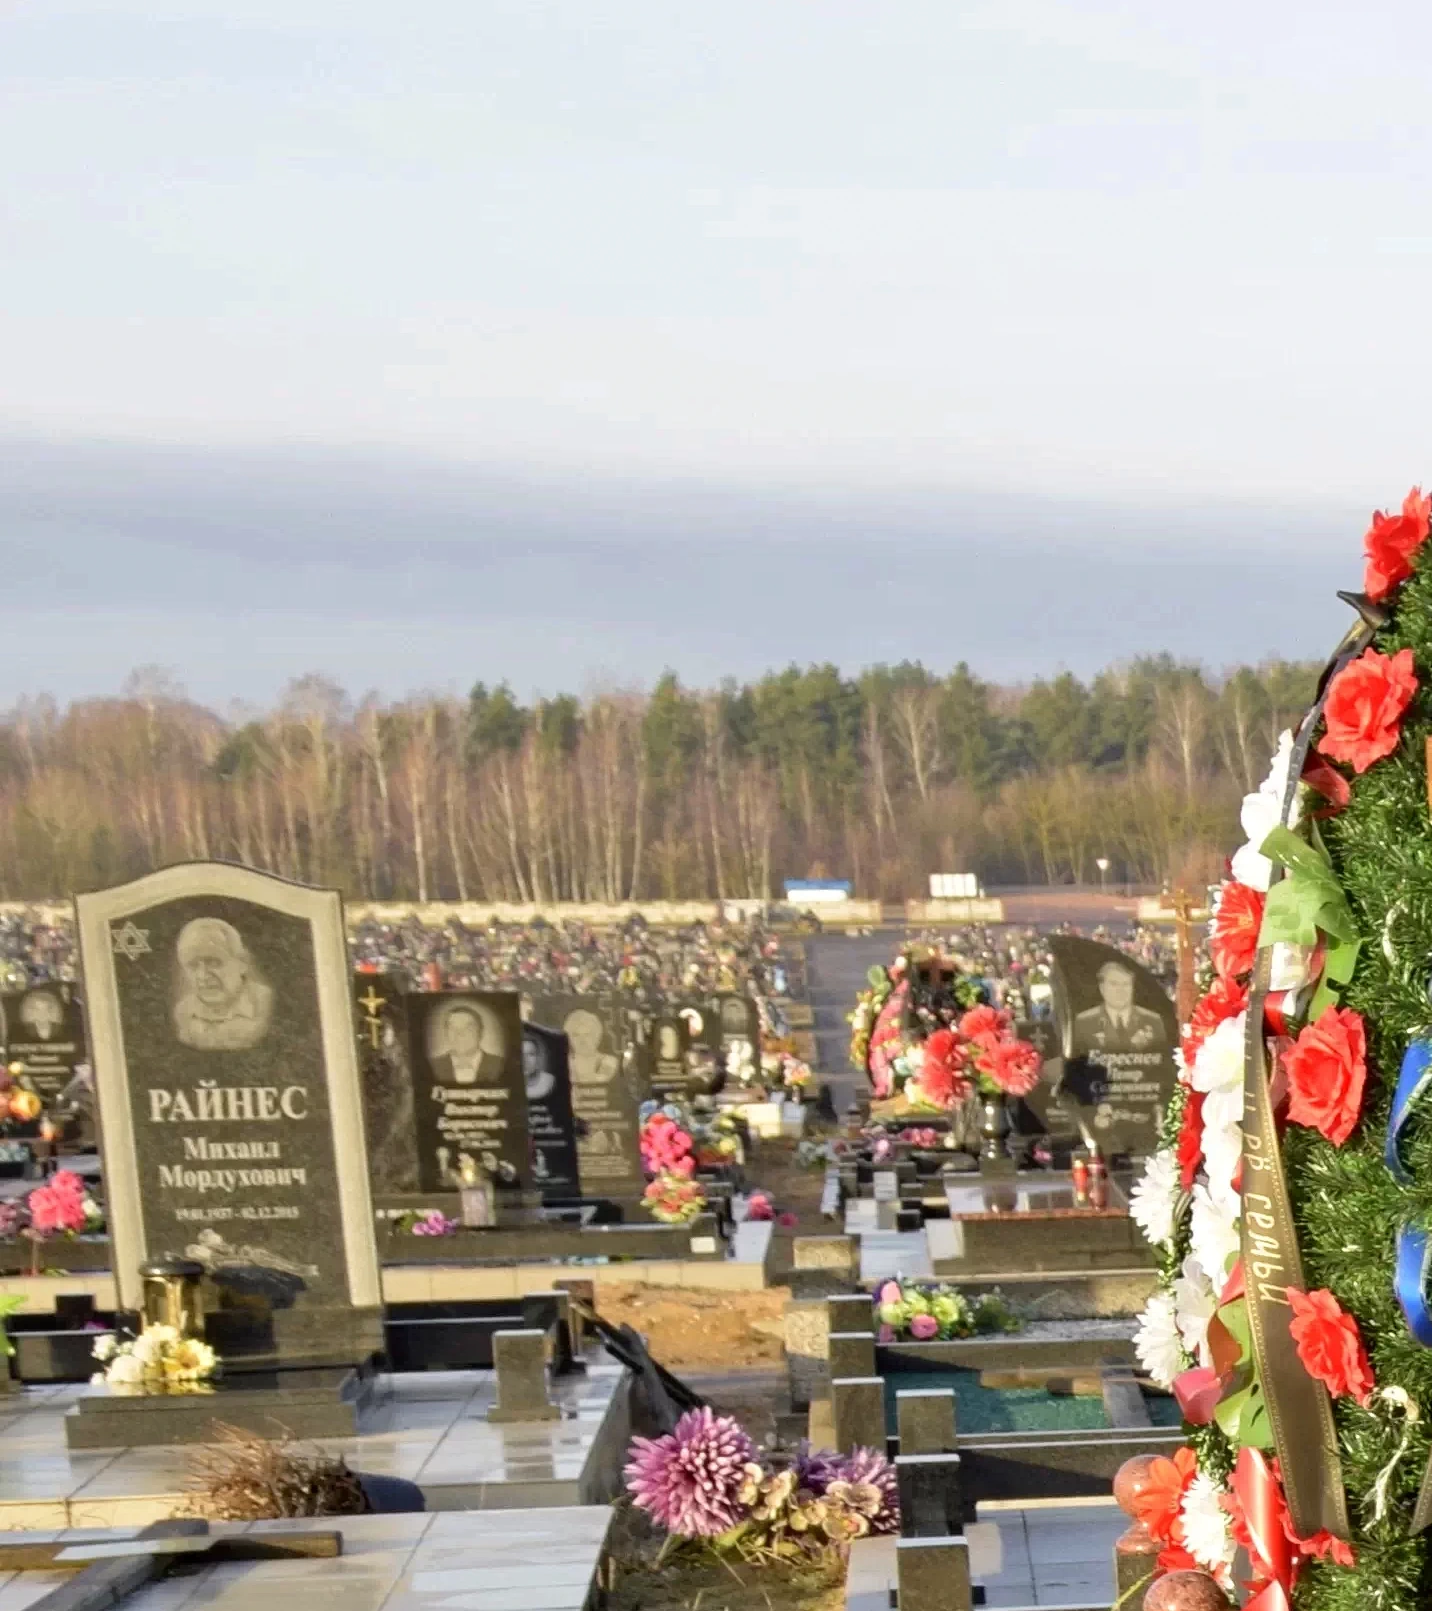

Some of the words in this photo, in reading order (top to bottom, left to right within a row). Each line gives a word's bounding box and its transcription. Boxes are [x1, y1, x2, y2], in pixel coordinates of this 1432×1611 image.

[148, 1079, 308, 1122] РАЙНЕС
[183, 1136, 281, 1161] Михаил
[158, 1164, 307, 1193] Мордухович
